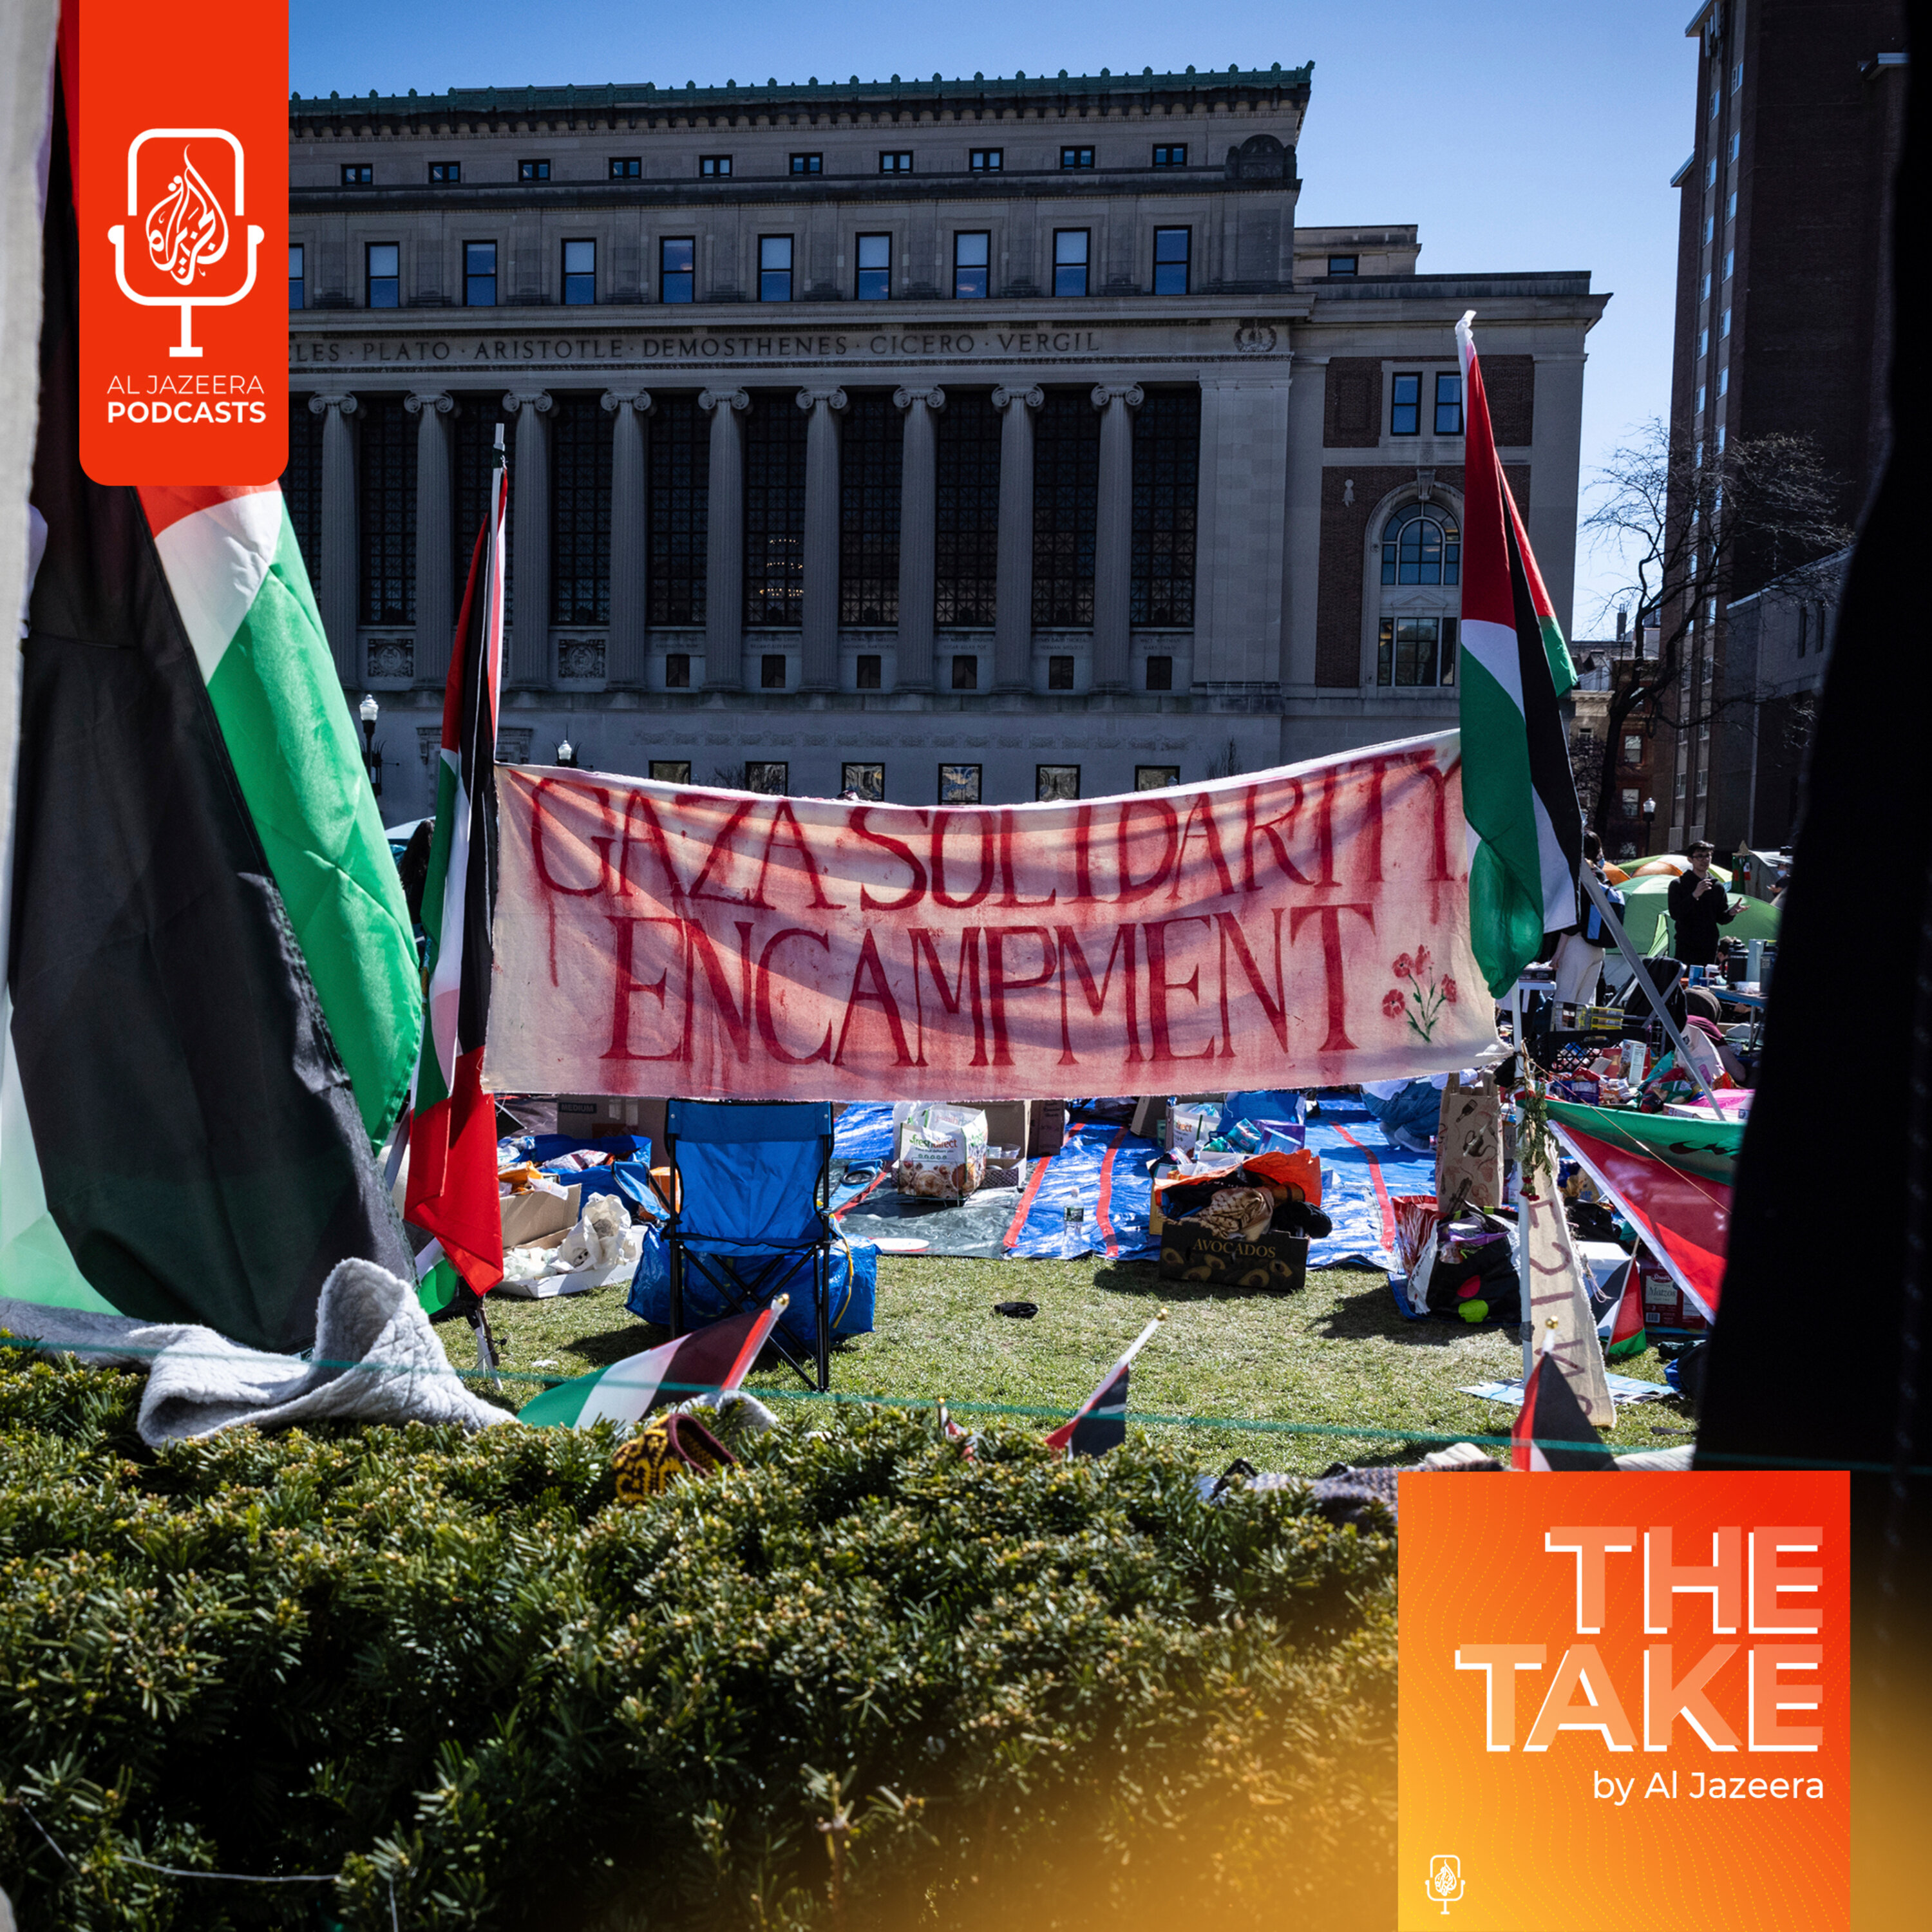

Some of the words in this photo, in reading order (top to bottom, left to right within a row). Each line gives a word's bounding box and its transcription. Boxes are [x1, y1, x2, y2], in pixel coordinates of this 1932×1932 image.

[289, 343, 339, 362] LES
[362, 341, 450, 361] PLATO
[473, 339, 623, 360] ARISTOTLE
[643, 336, 846, 357] DEMOSTHENES
[869, 334, 974, 354] CICERO
[997, 332, 1099, 352] VERGIL
[531, 777, 846, 911] GAZA
[849, 748, 1461, 911] SOLIDARITY
[600, 902, 1376, 1067] ENCAMPMENT
[561, 1103, 594, 1112] MEDIUM
[1193, 1238, 1276, 1258] AVOCADOS
[1649, 1287, 1676, 1298] Matzos
